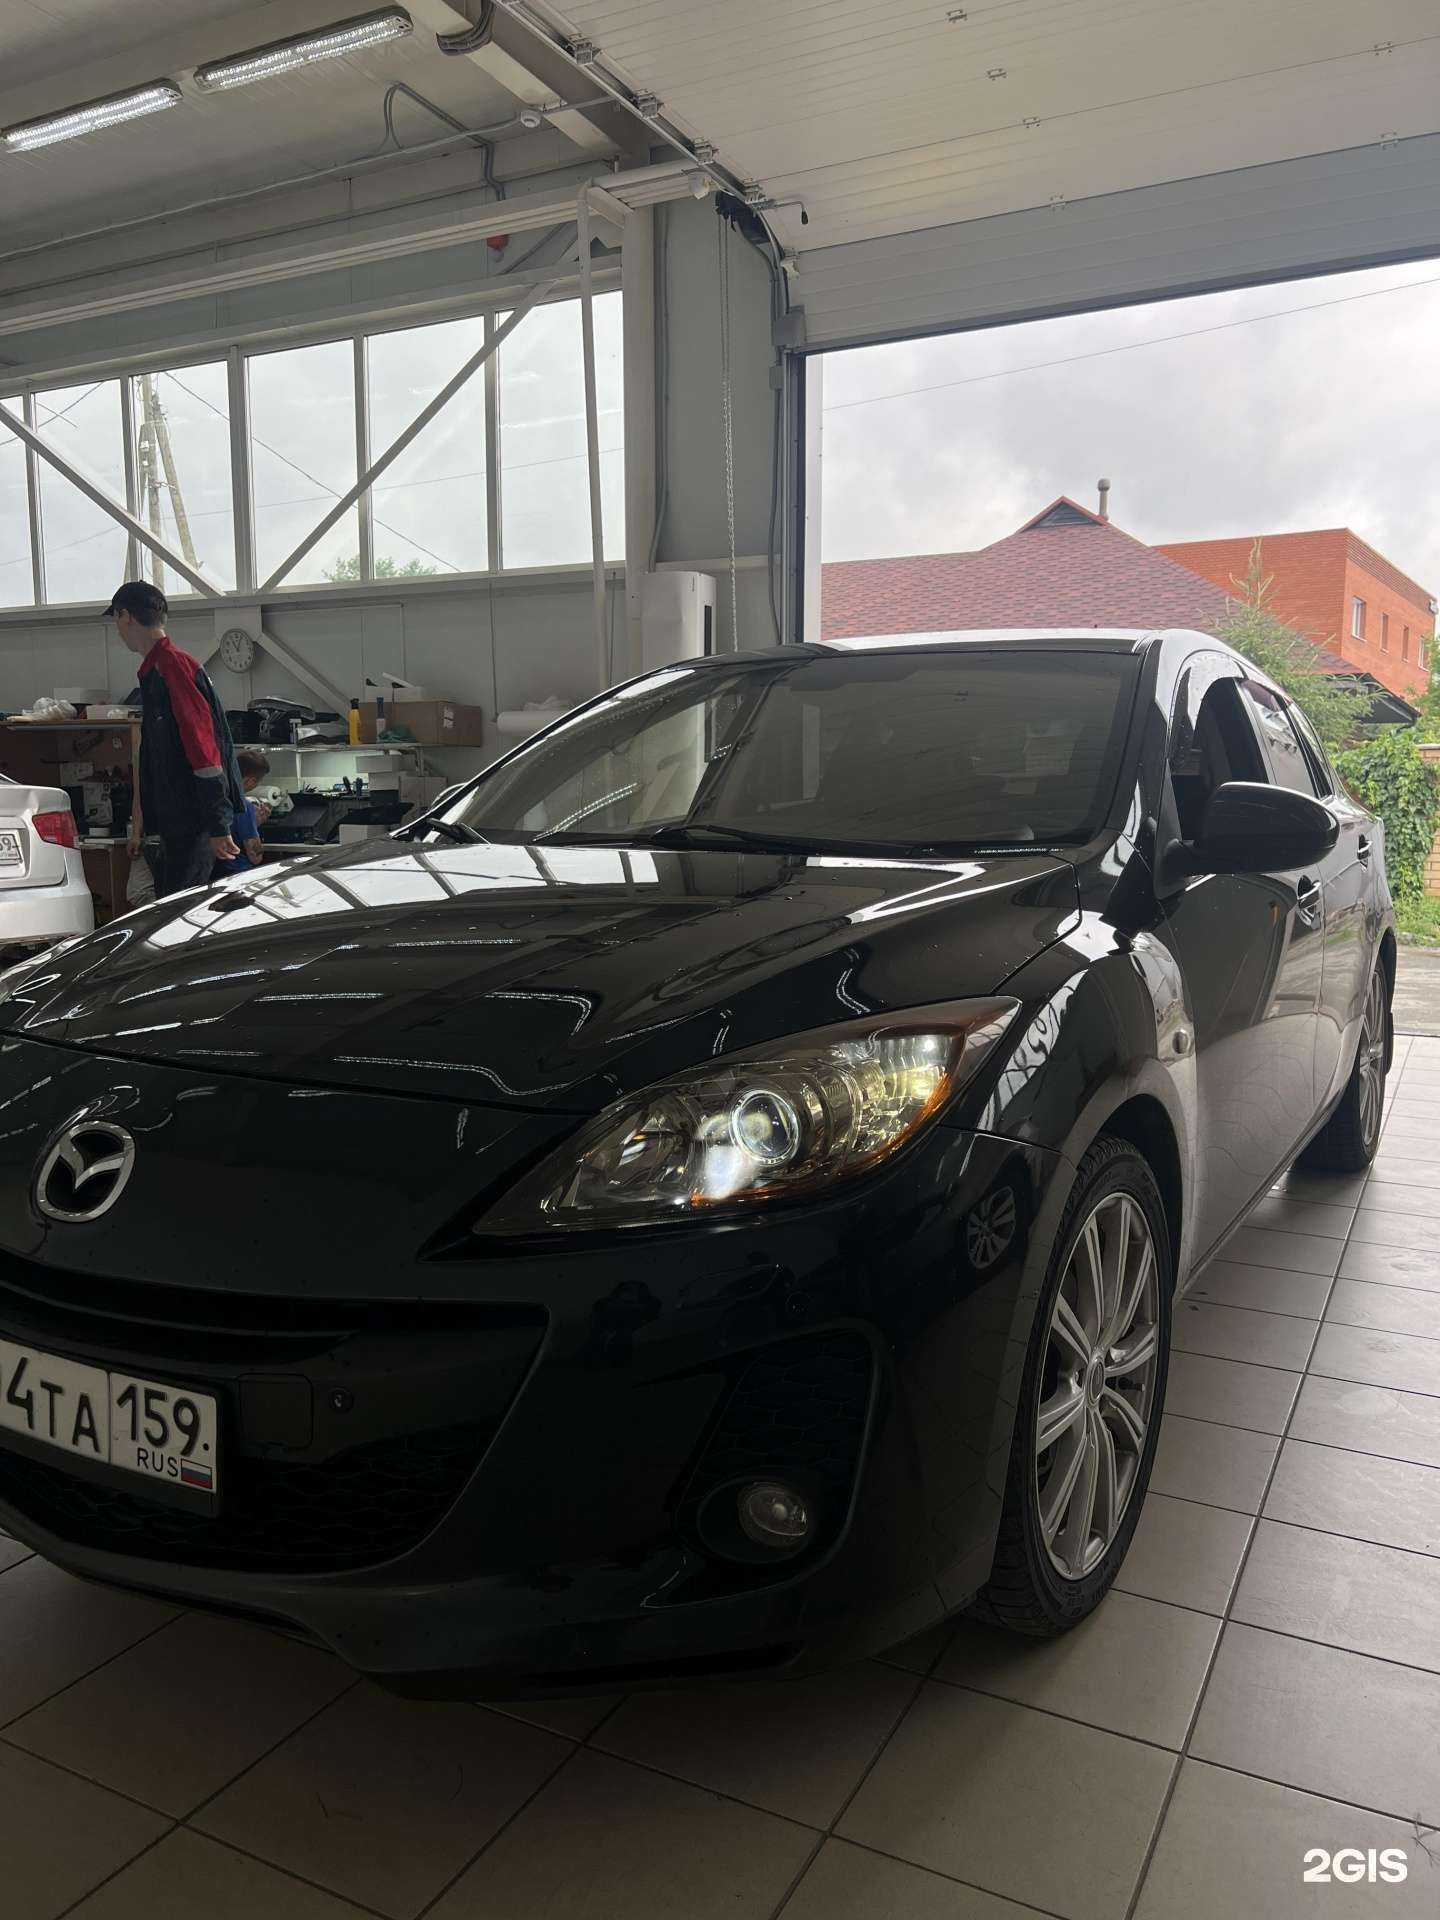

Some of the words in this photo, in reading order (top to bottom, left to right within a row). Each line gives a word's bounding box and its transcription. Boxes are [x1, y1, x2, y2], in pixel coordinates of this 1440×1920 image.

[0, 1356, 99, 1453] 4TA
[116, 1383, 201, 1457] 159
[136, 1447, 179, 1478] RUS
